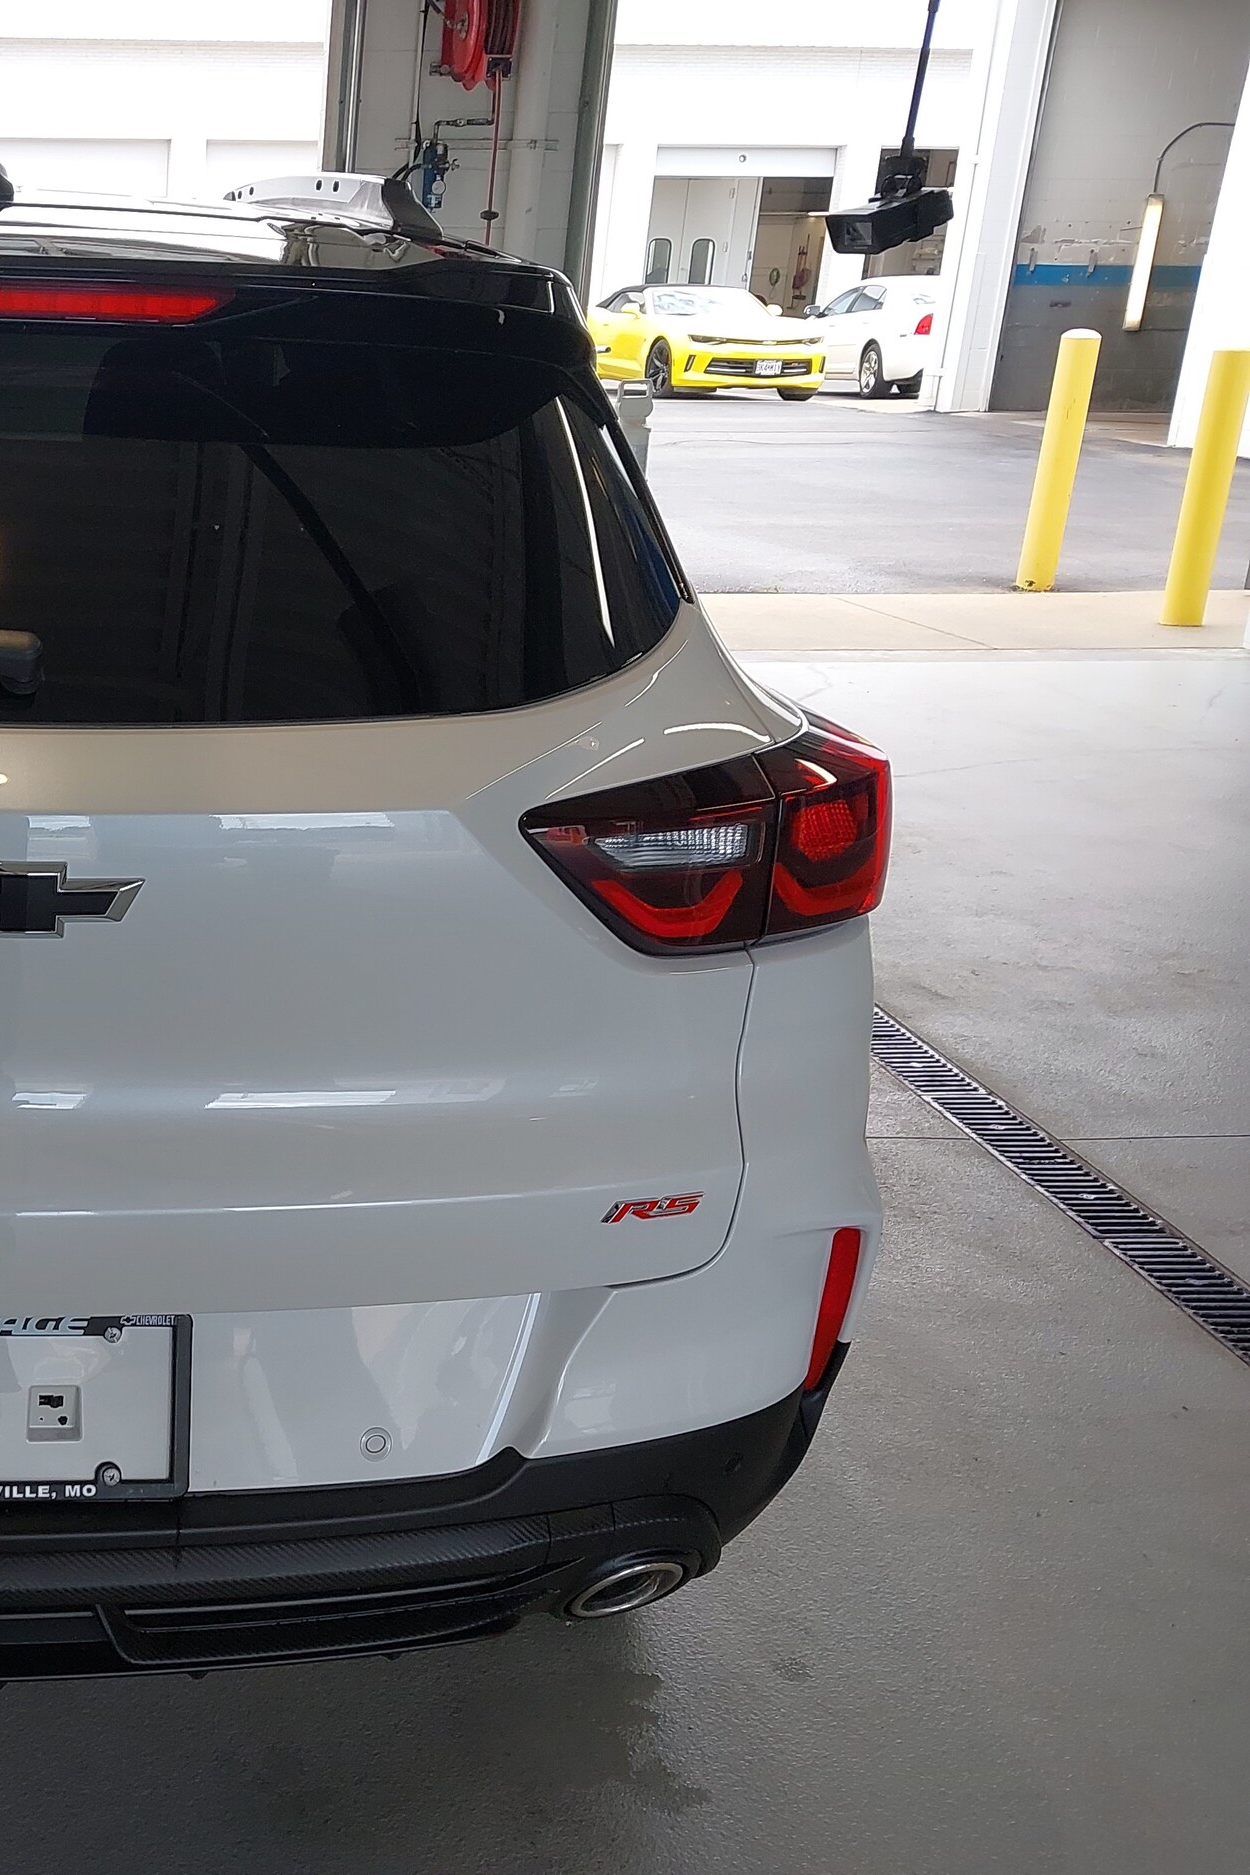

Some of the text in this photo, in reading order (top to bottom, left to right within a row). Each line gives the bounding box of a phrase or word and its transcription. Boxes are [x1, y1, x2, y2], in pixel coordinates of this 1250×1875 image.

[600, 1191, 705, 1224] RS
[136, 1315, 176, 1326] CHEVROLET
[65, 1485, 97, 1498] MO
